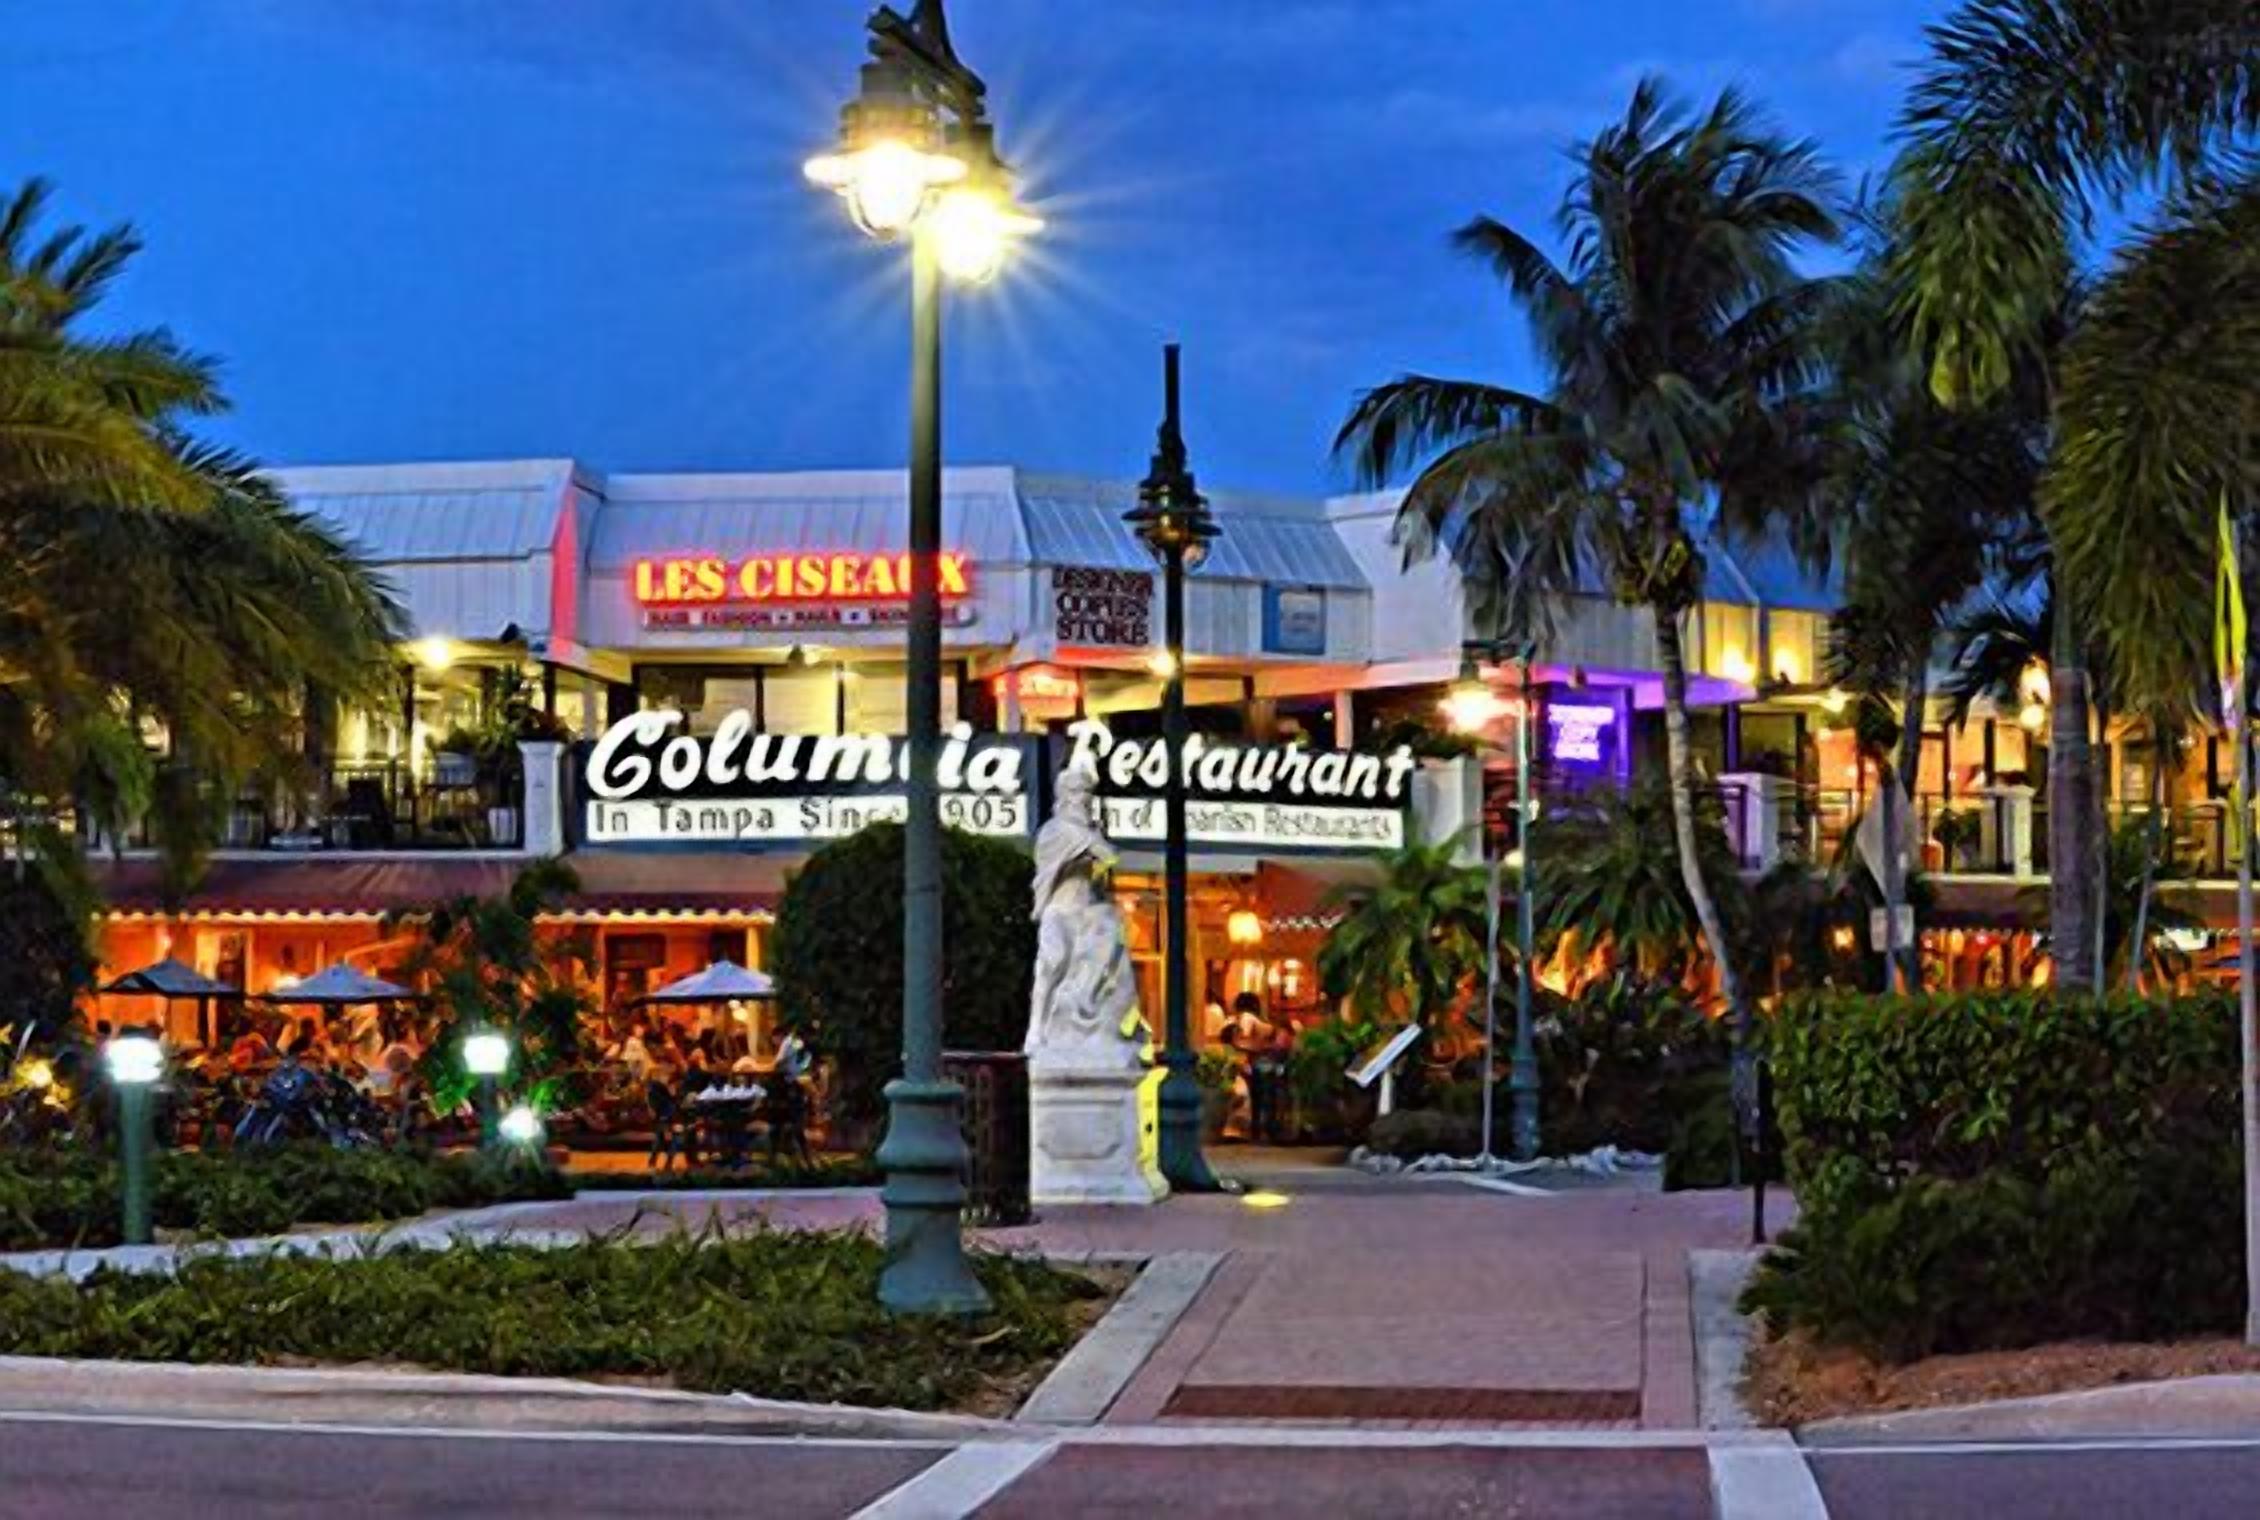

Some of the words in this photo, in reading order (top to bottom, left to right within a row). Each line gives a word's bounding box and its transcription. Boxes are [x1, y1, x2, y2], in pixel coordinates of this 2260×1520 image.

[636, 558, 726, 600] LES
[596, 803, 628, 832] In
[654, 801, 774, 838] Tampa
[939, 798, 1017, 828] 905
